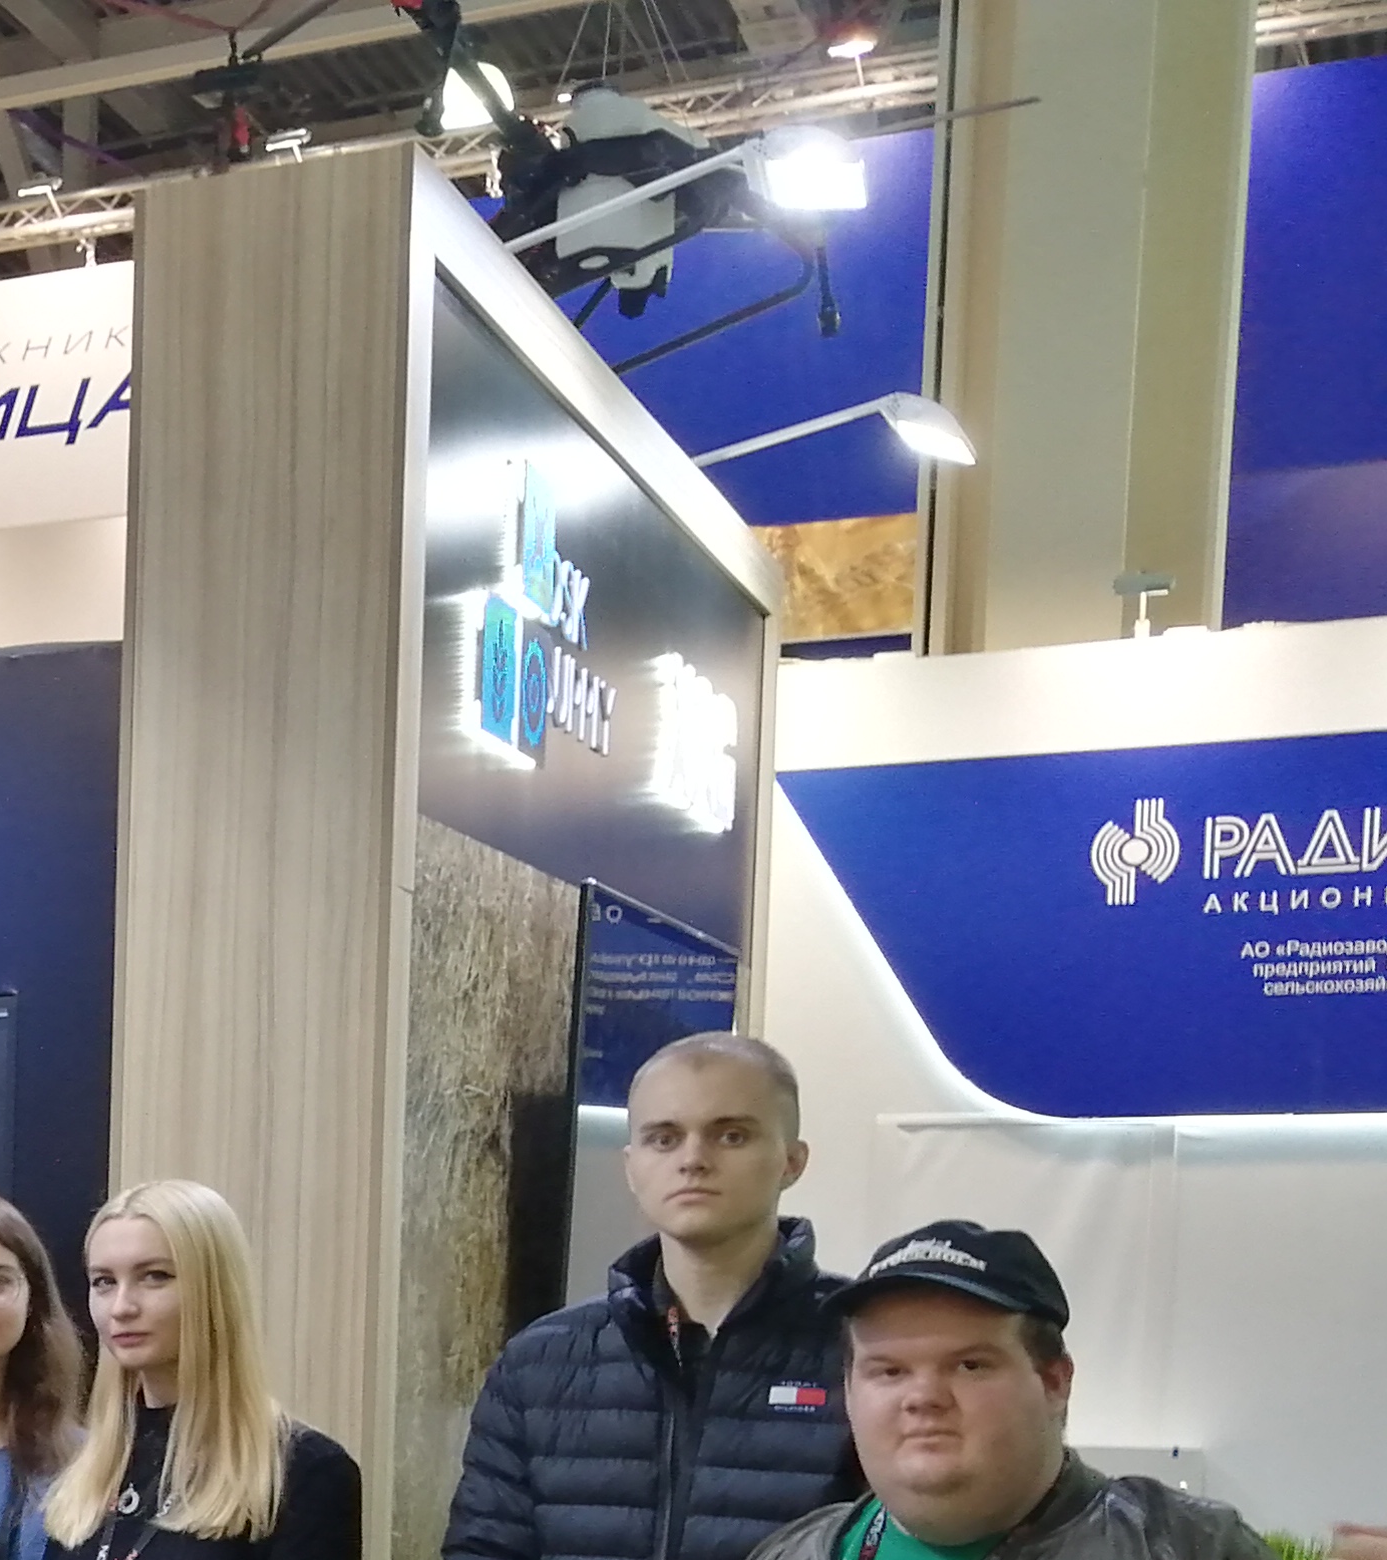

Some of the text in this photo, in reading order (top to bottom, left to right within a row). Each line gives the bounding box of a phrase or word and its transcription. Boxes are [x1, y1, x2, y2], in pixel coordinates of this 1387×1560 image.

[1203, 885, 1387, 916] АКЦИОН
[1240, 940, 1271, 960] АО
[1252, 956, 1377, 980] предприятий
